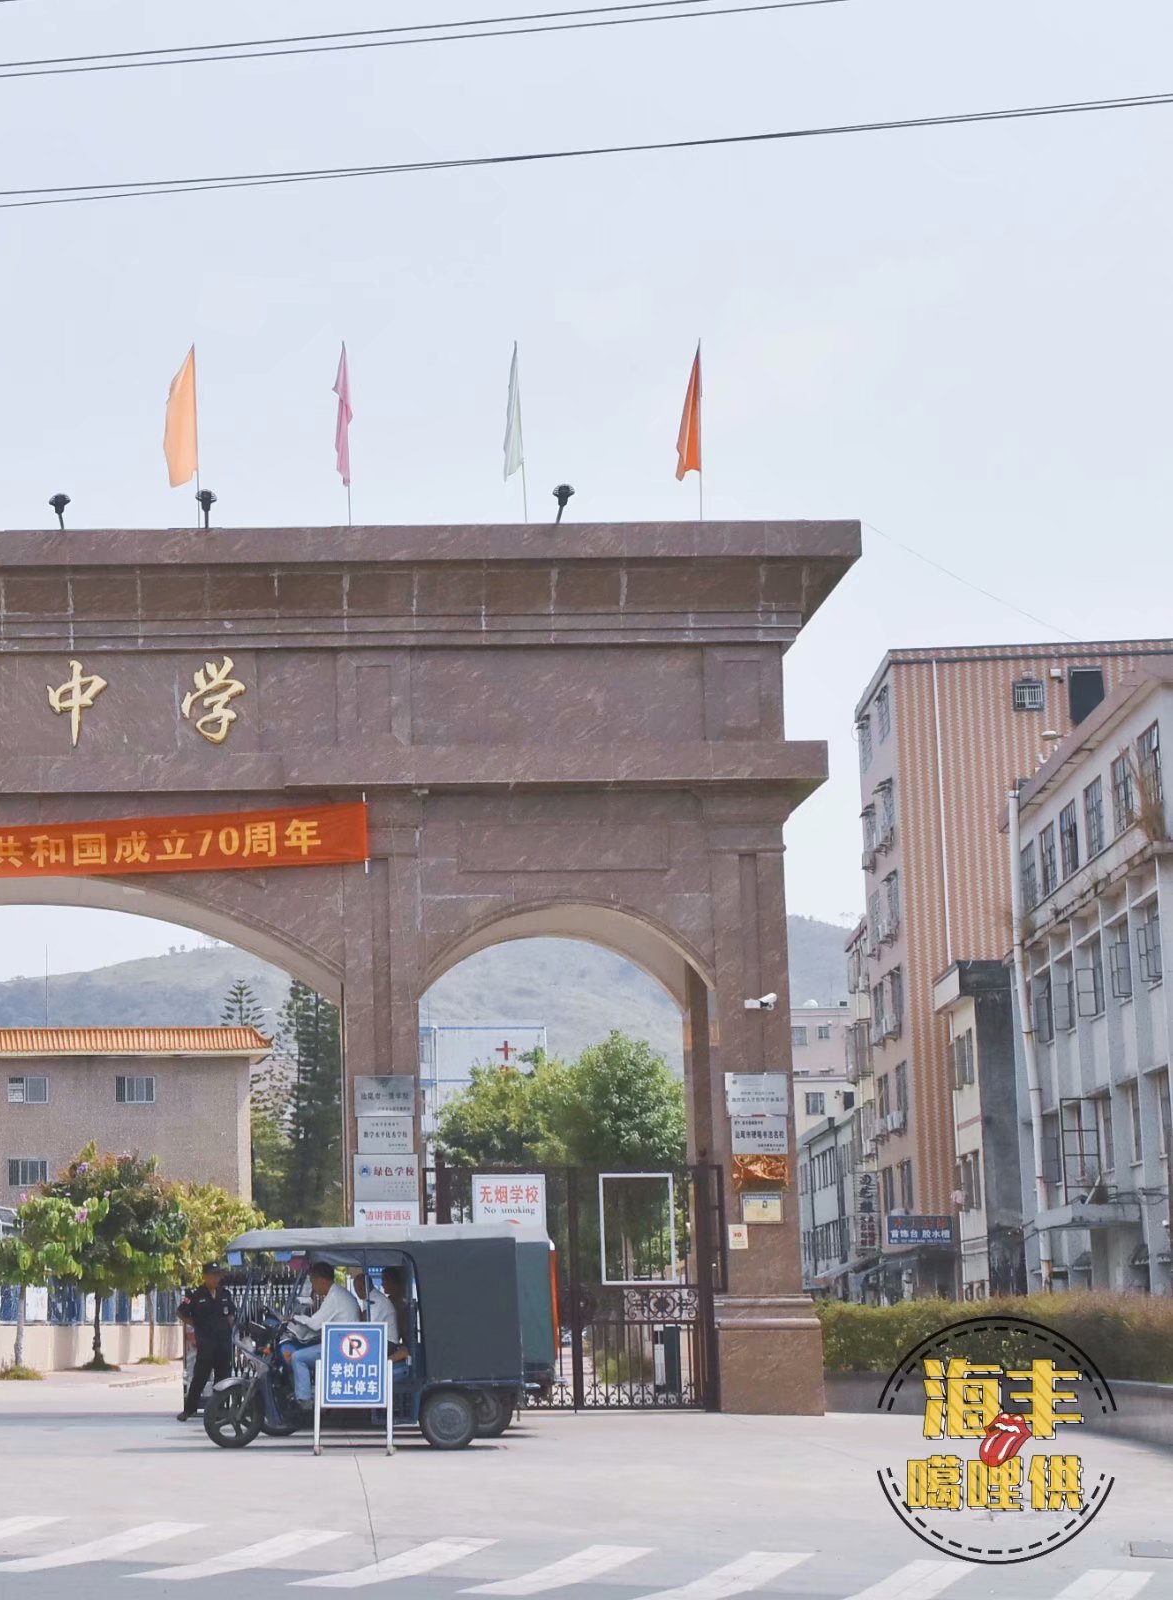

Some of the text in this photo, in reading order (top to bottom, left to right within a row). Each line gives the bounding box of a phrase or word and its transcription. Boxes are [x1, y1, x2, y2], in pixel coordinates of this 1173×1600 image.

[373, 1166, 415, 1177] 绿色学校
[479, 1184, 539, 1204] 无烟学校
[365, 1210, 412, 1221] 请讲普通话
[483, 1206, 536, 1215] No smoking
[331, 1363, 378, 1378] 学校门口
[331, 1380, 378, 1395] 禁止停车
